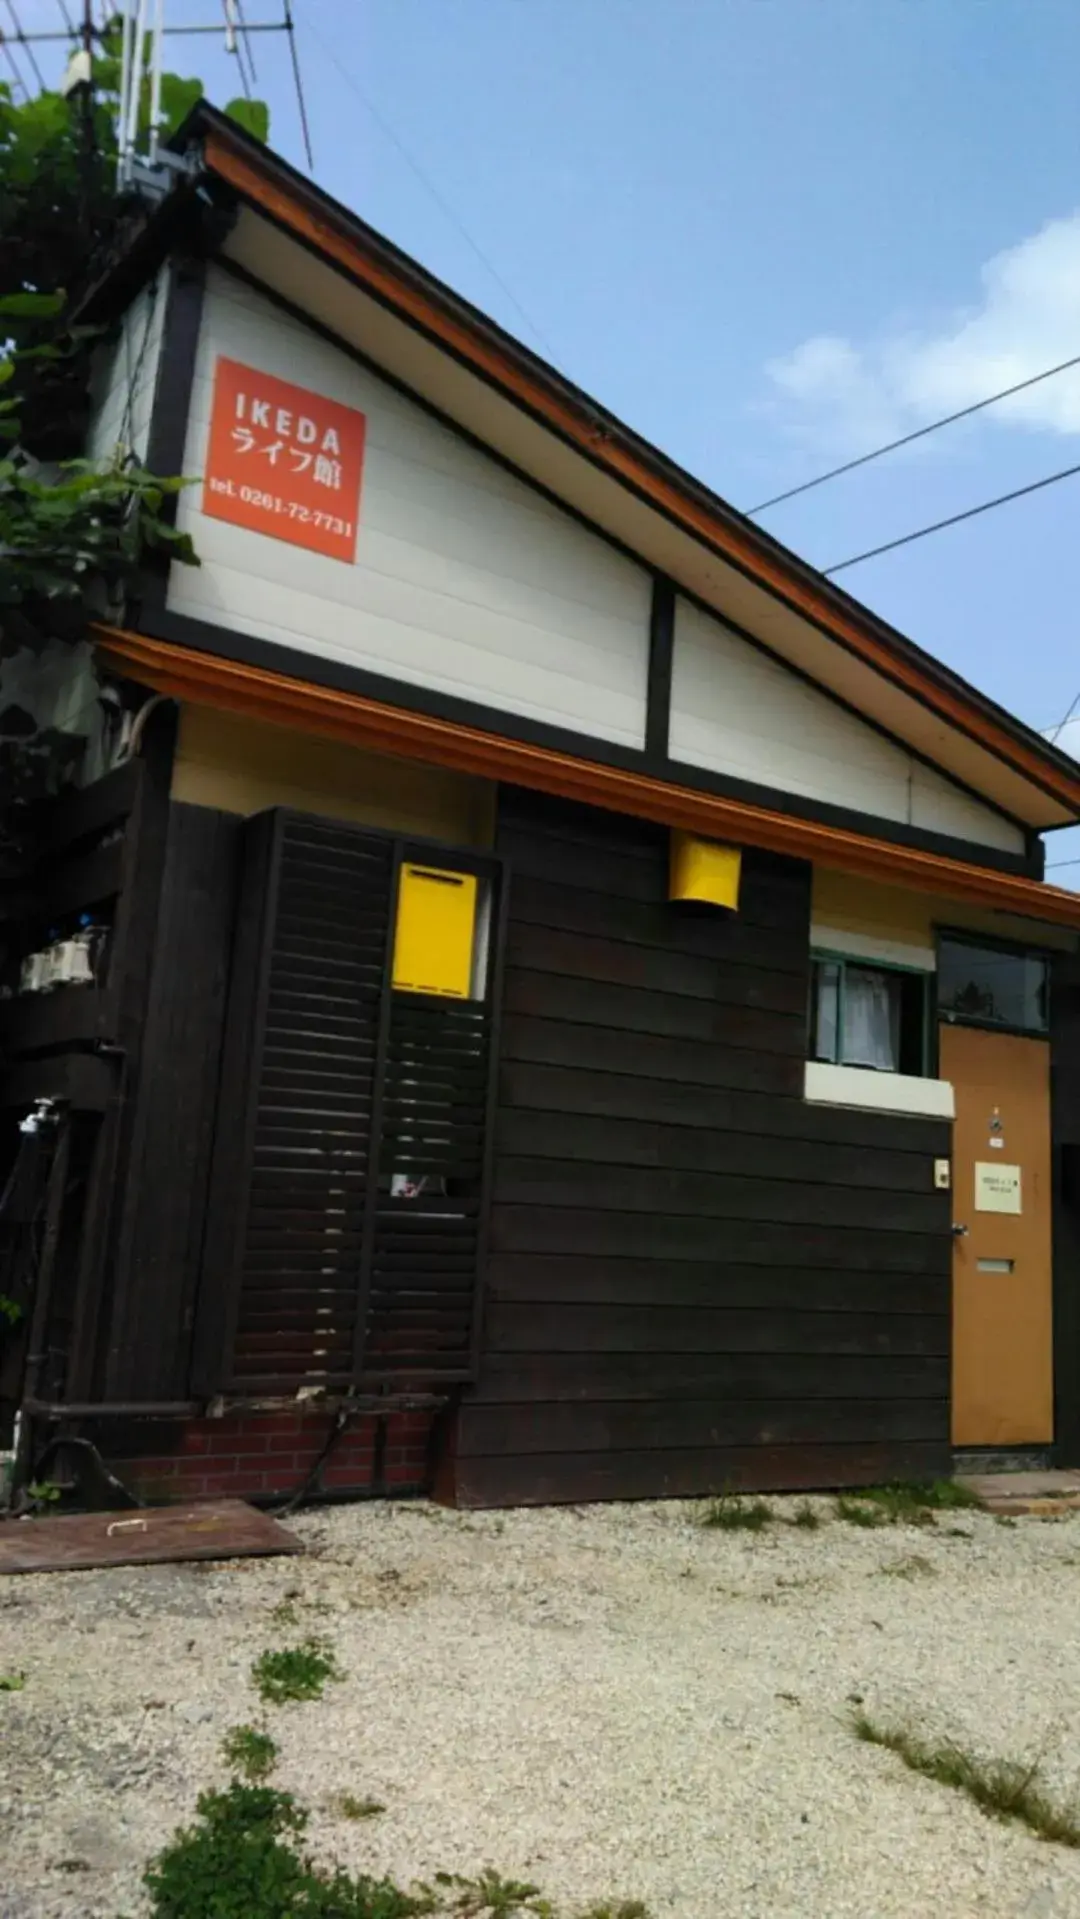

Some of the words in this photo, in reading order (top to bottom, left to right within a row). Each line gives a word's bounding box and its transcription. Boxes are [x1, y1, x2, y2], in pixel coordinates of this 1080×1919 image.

[235, 393, 341, 455] IKEDA
[231, 427, 342, 490] ライフ館
